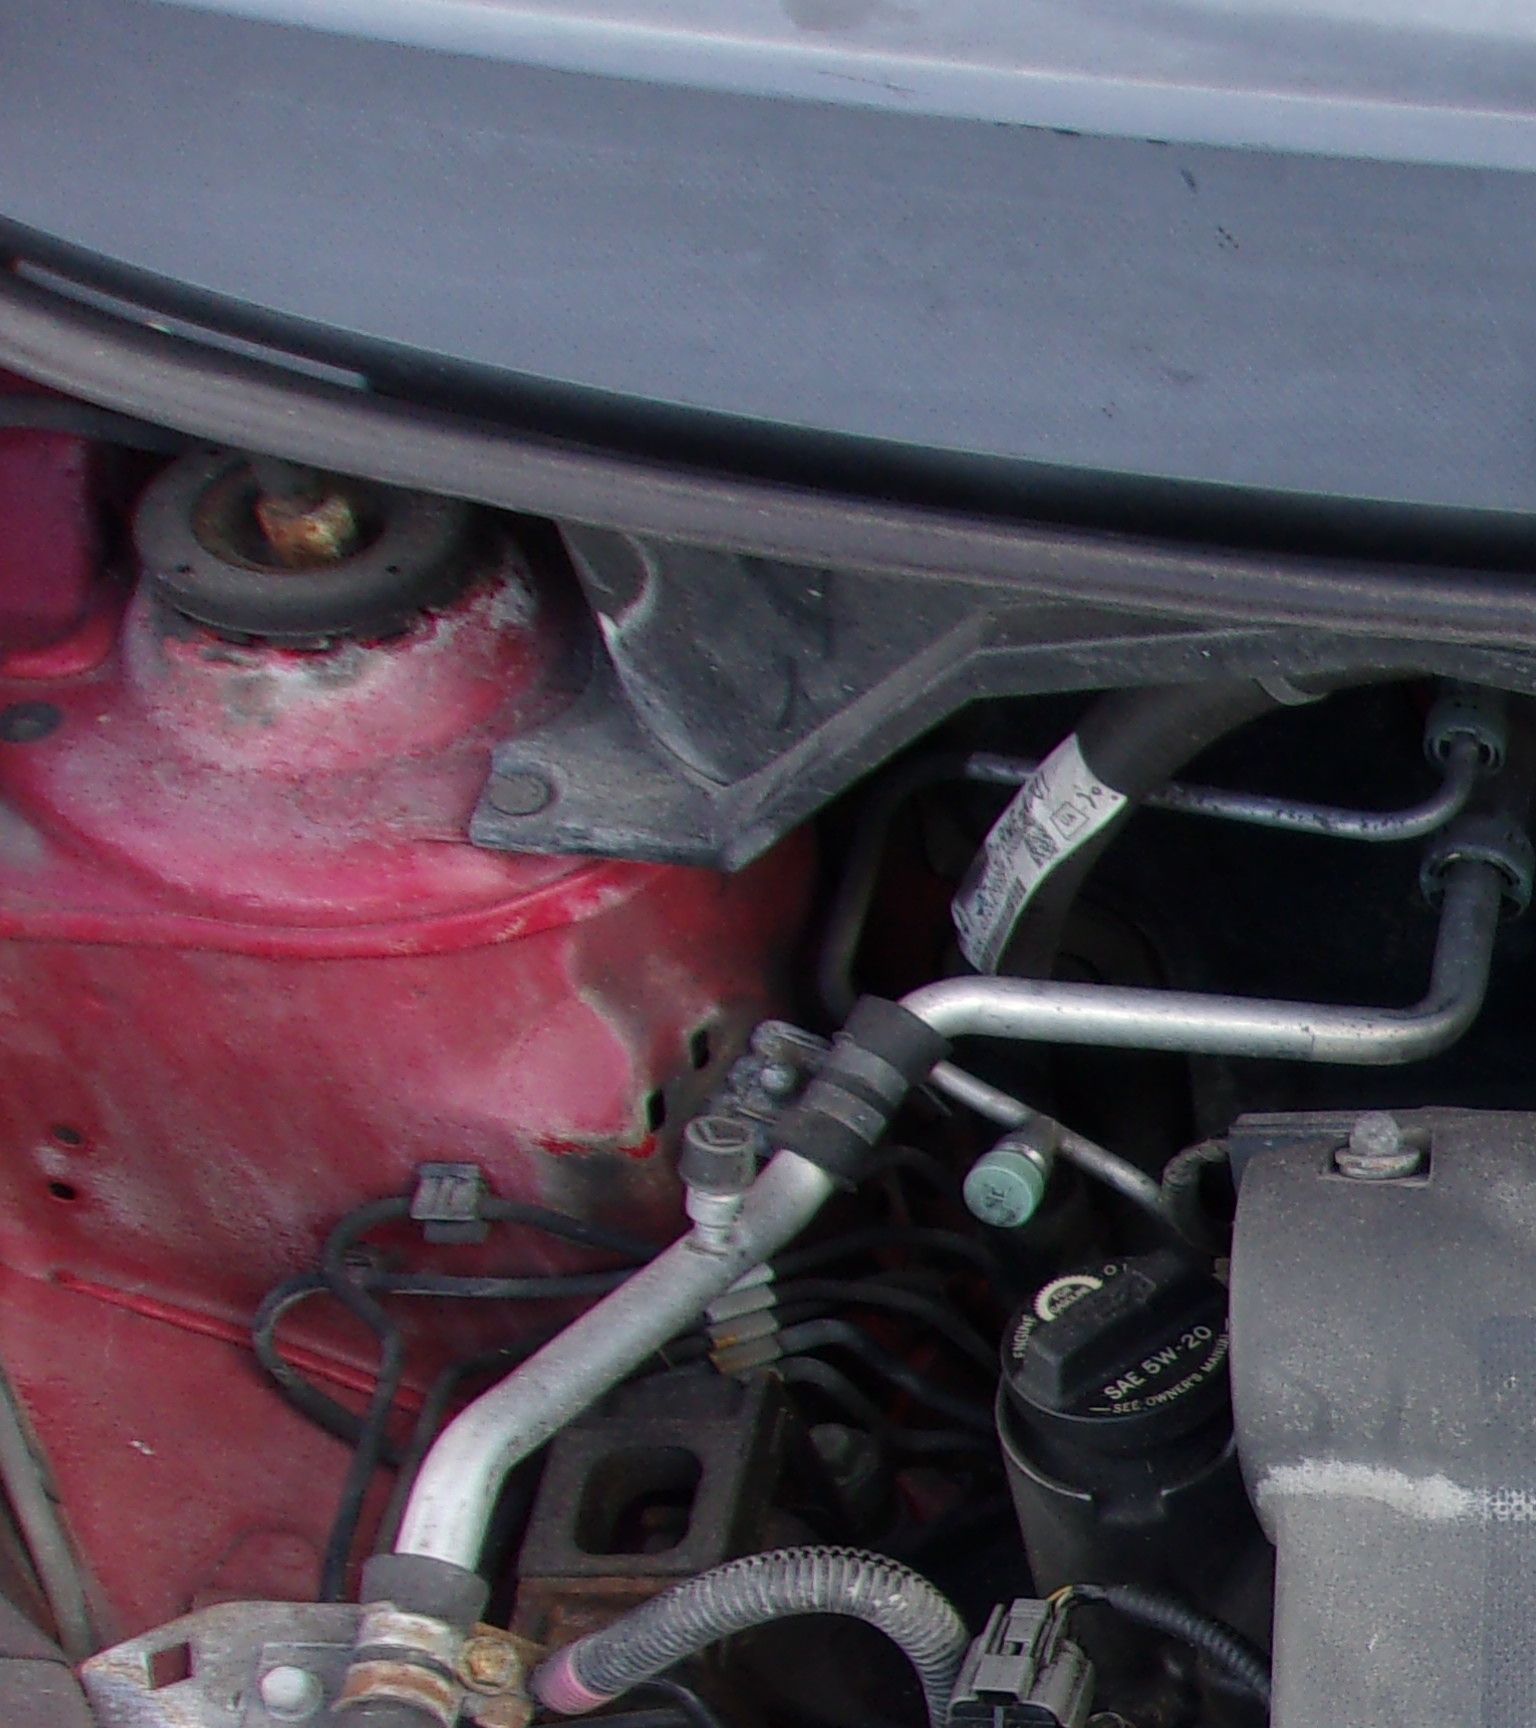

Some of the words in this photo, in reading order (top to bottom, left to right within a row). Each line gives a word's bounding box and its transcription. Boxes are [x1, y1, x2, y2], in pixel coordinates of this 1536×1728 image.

[1103, 1370, 1148, 1401] SAE
[1143, 1324, 1213, 1376] 5W-20
[1112, 1400, 1141, 1415] SEE
[1146, 1371, 1204, 1407] OWNER'S
